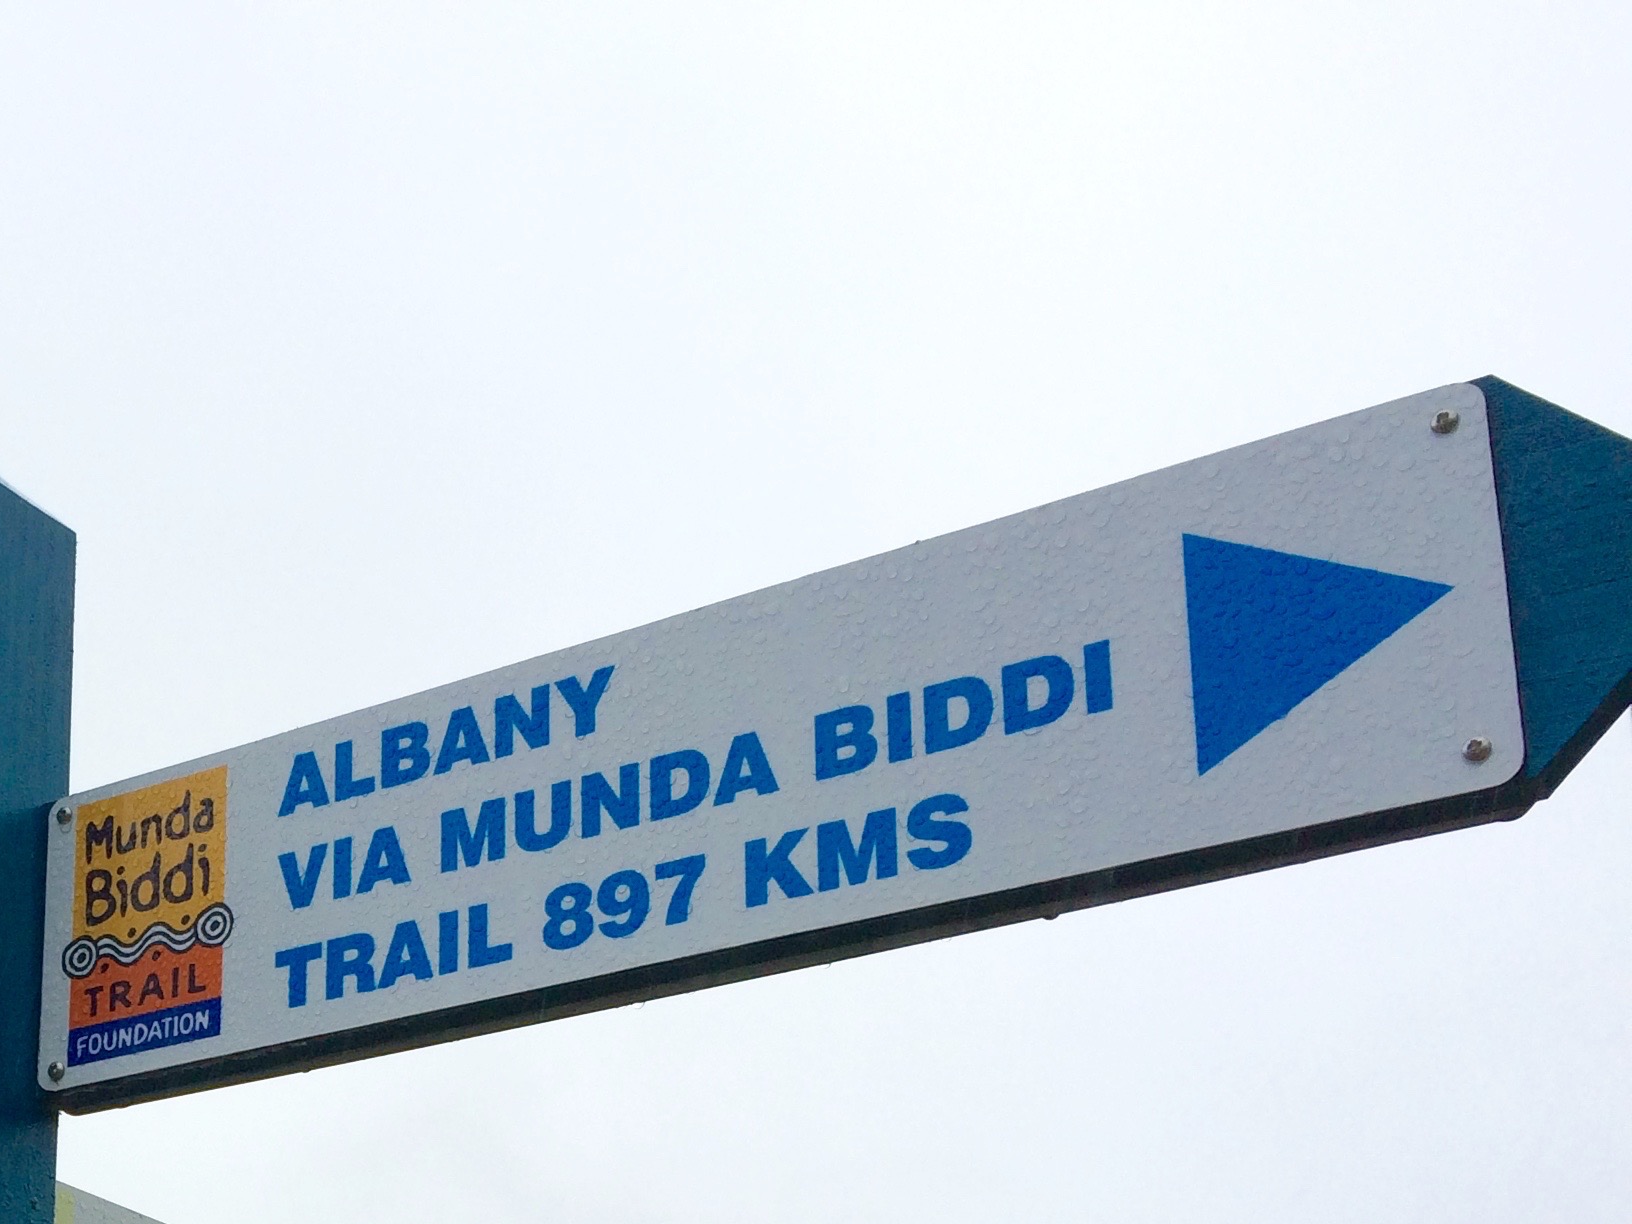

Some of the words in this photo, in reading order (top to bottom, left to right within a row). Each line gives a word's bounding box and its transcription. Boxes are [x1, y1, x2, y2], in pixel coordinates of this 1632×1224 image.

[277, 664, 616, 817] ALBANY
[277, 825, 412, 910] VIA
[440, 730, 780, 873] MUNDA
[814, 639, 1114, 782] BIDDI
[85, 790, 214, 864] Munda
[85, 843, 210, 927] Biddi
[274, 902, 514, 1008] TRAIL
[542, 853, 708, 951] 897
[744, 792, 973, 909] KMS
[84, 963, 206, 1018] TRAIL
[76, 1009, 210, 1058] FOUNDATION
